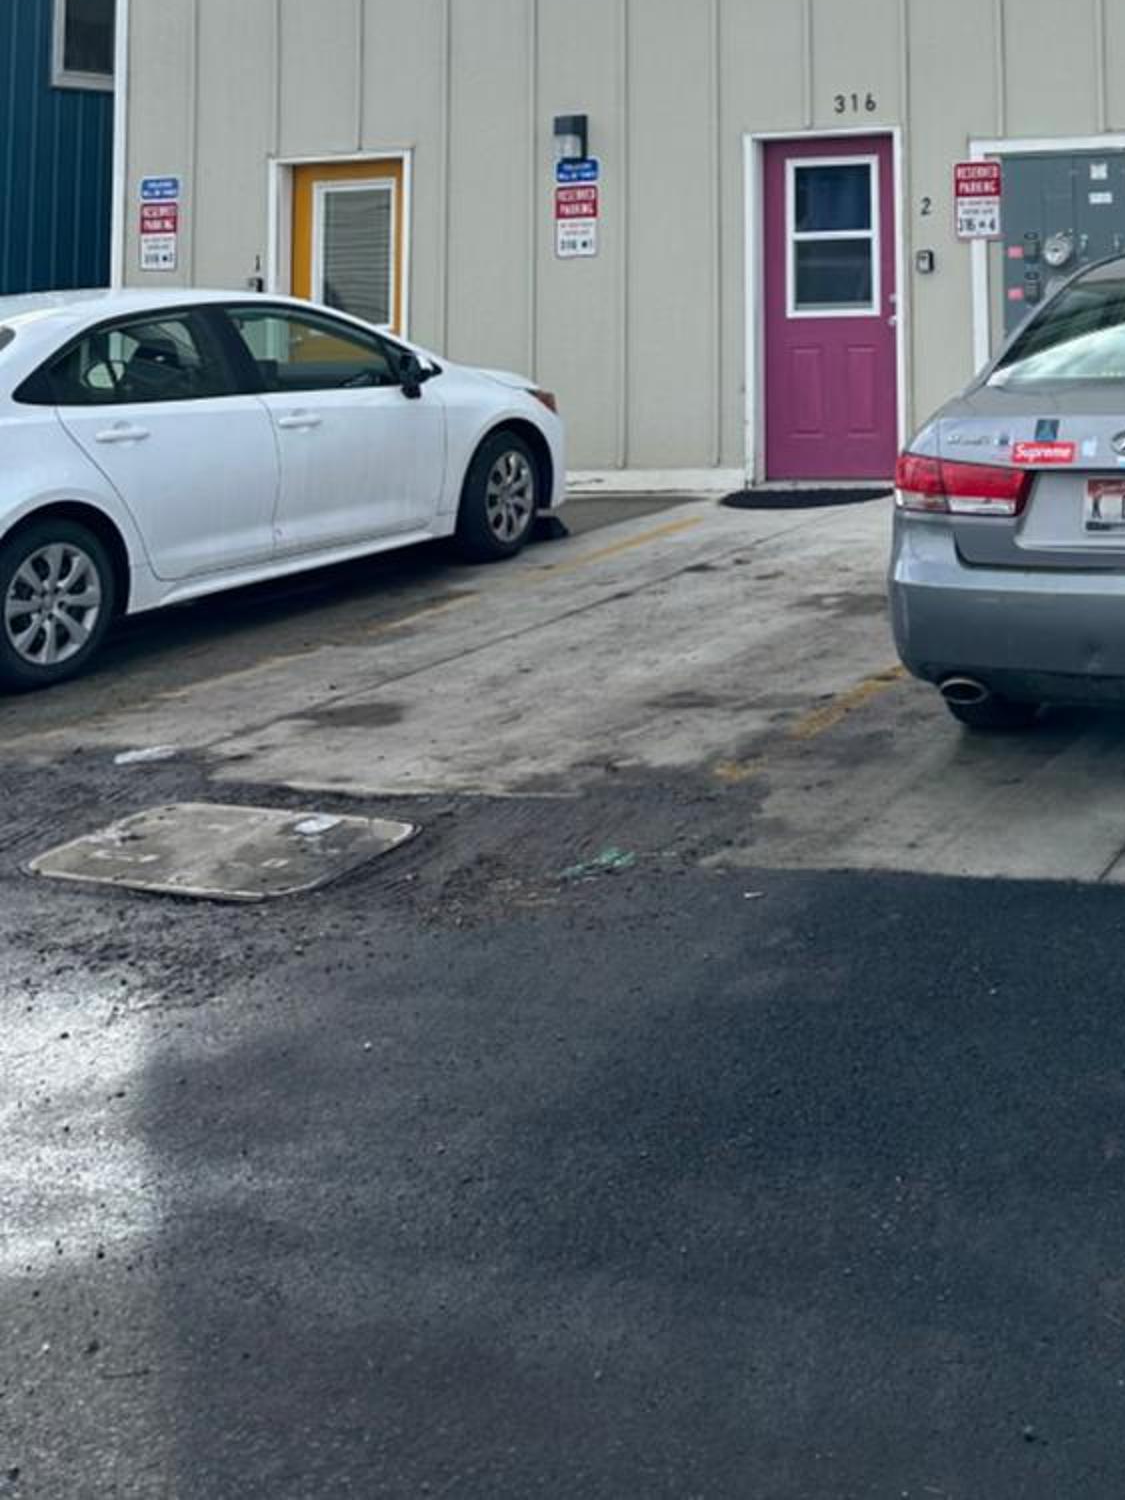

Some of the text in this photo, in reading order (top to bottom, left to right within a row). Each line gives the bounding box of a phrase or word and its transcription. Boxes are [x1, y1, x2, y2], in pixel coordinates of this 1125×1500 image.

[834, 93, 877, 114] 316
[957, 165, 999, 179] RESERVED
[959, 180, 998, 194] PARKING
[920, 197, 931, 215] 2
[1015, 443, 1071, 463] Supreme
[1091, 495, 1103, 518] K
